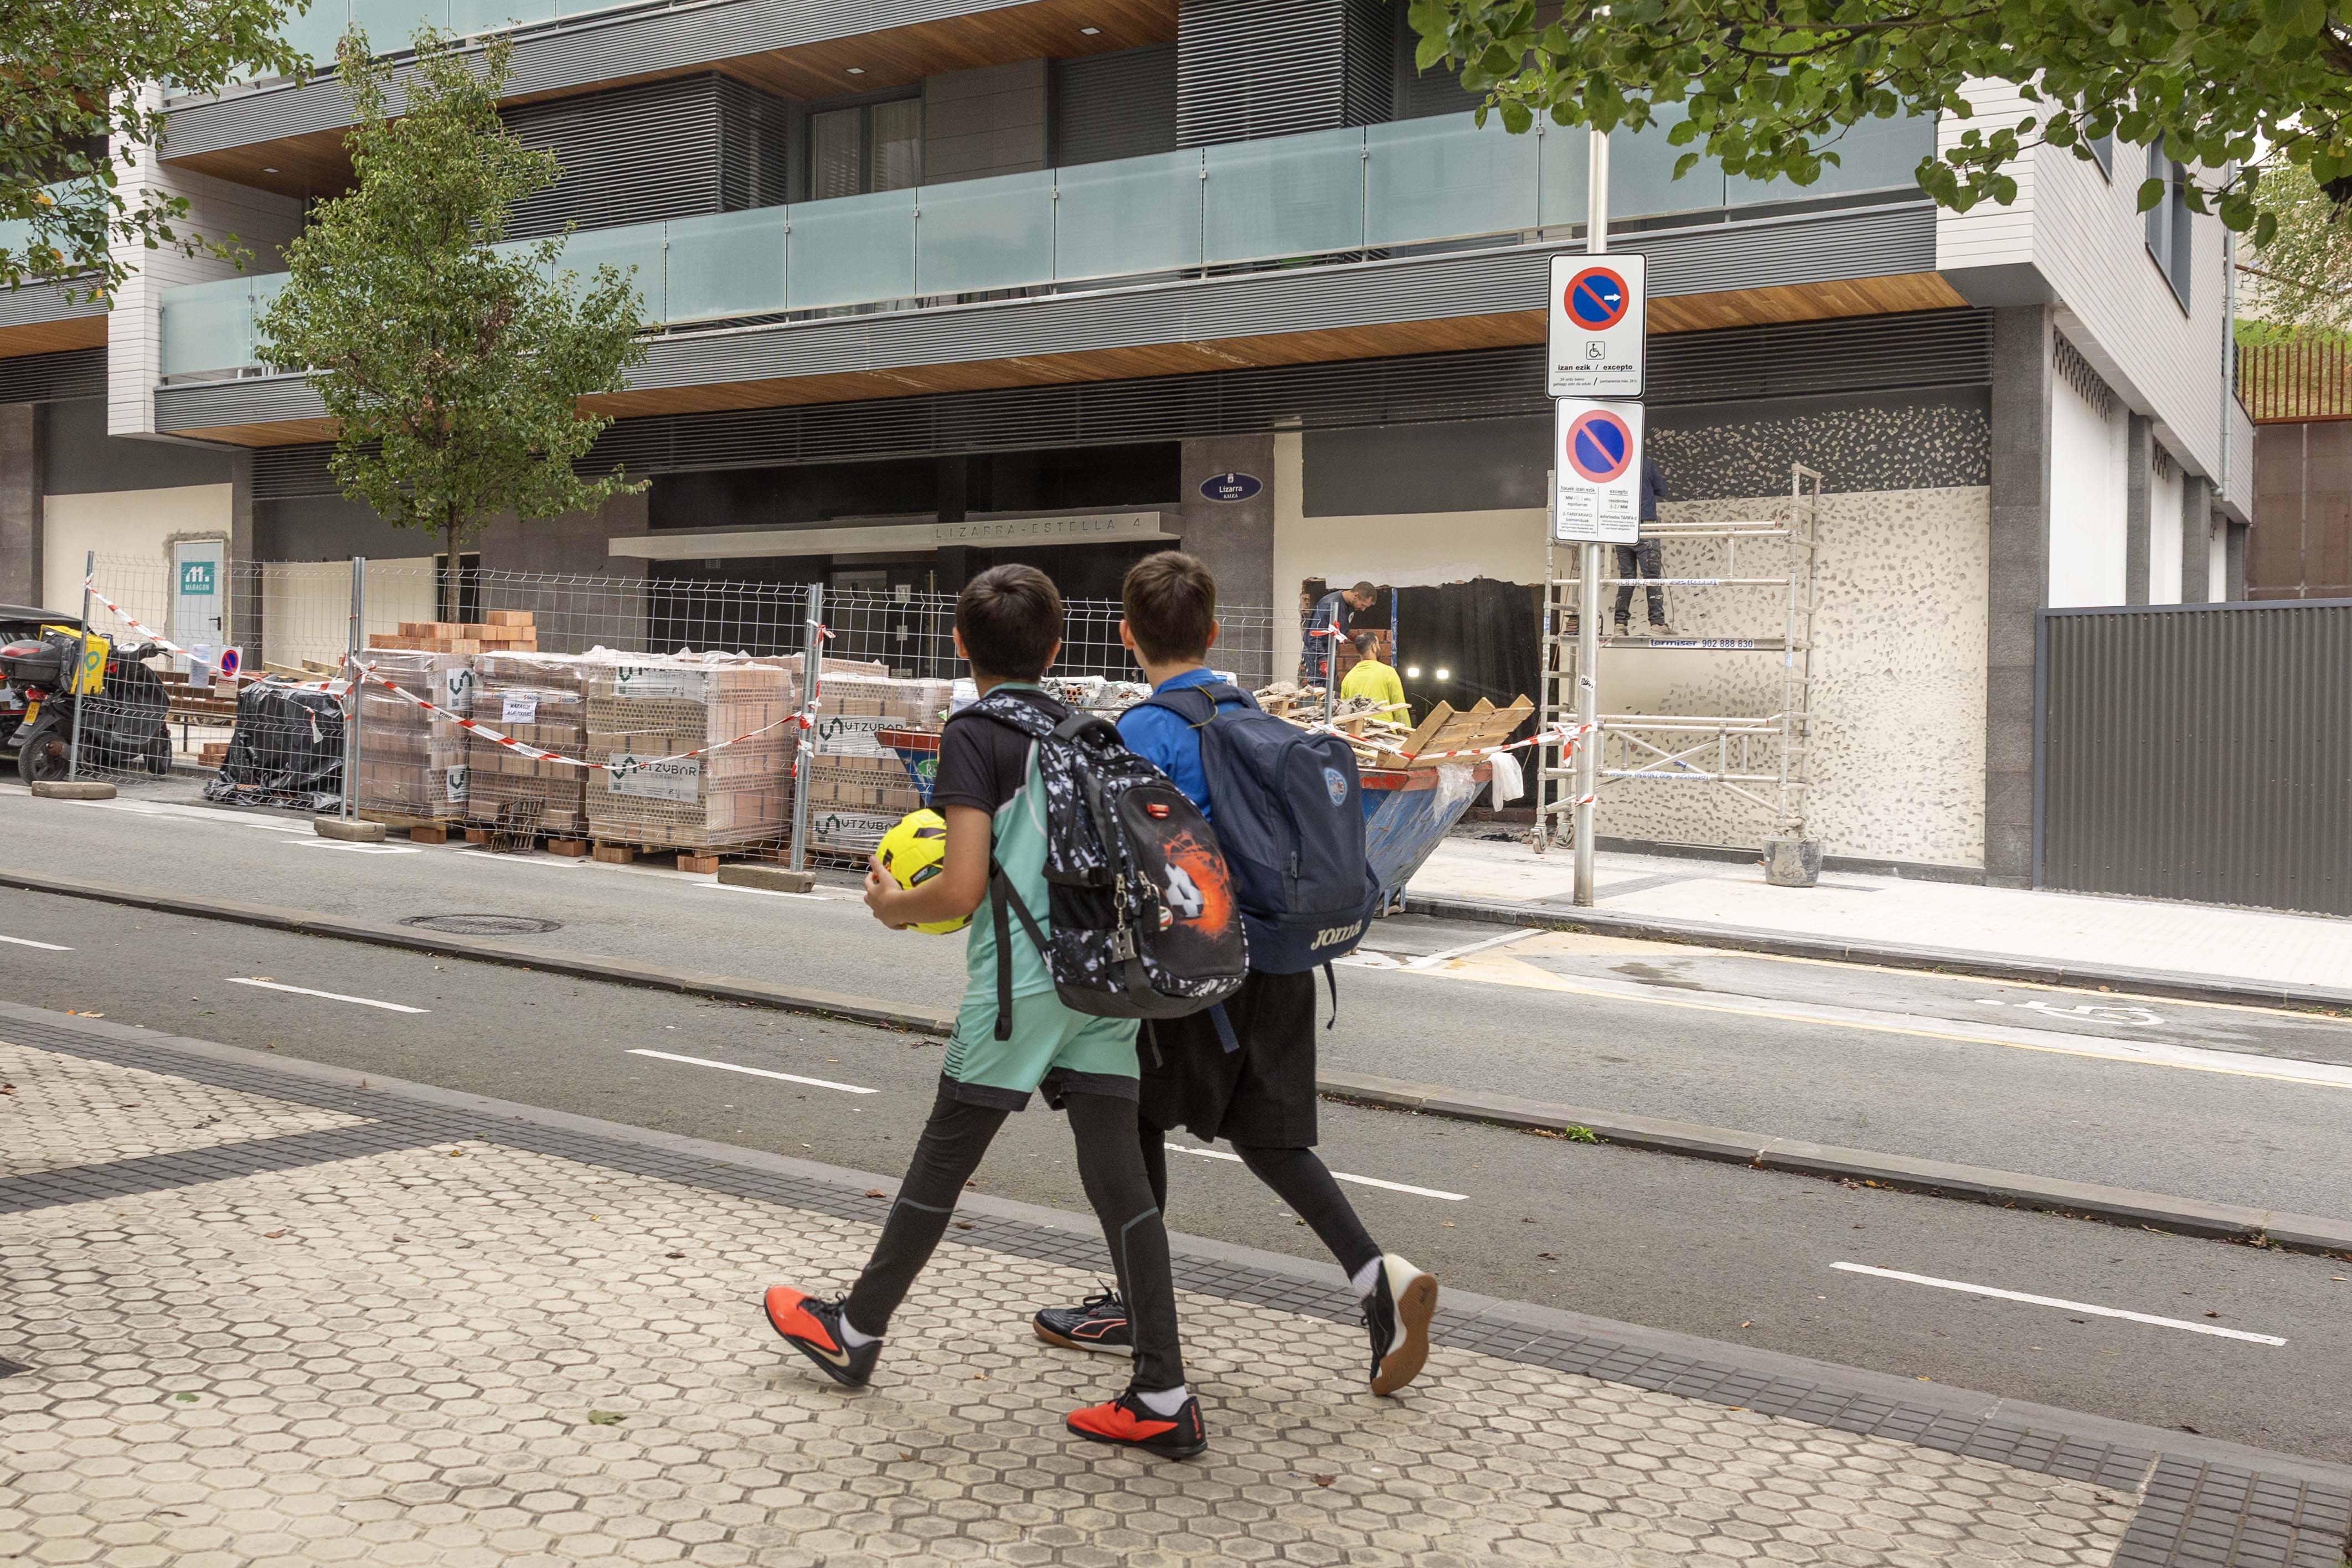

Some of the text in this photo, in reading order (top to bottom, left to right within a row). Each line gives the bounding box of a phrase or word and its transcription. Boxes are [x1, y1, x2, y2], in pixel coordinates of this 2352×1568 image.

[936, 518, 1140, 538] LIZARRA-ESTELLA 4
[1737, 639, 1753, 648] 830
